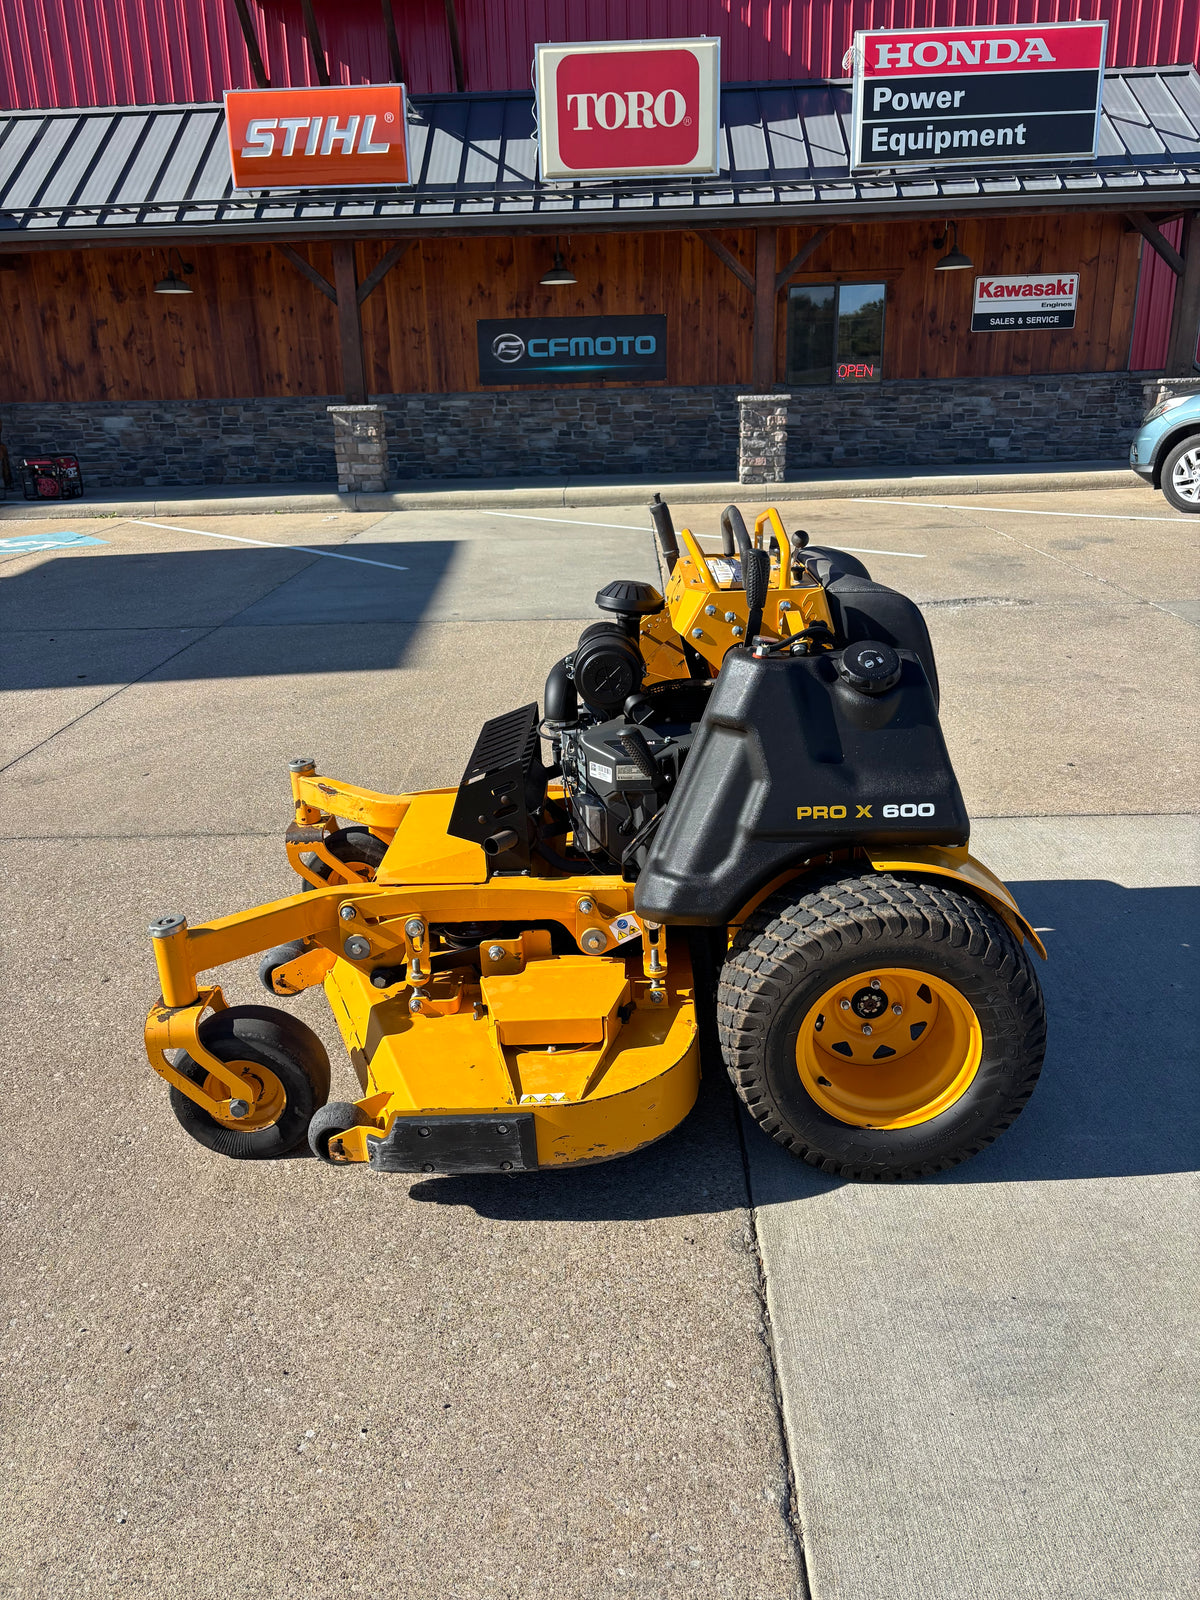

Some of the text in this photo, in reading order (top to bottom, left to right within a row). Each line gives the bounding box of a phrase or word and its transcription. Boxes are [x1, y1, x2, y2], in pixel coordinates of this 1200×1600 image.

[874, 37, 1057, 69] HONDA
[566, 89, 687, 131] TORO
[872, 86, 966, 112] Power
[240, 114, 391, 158] STIHL
[871, 122, 1027, 156] Equipment
[978, 278, 1075, 299] Kawasaki
[989, 315, 1060, 326] SALES & SERVICE
[527, 335, 657, 358] CFMOTO
[838, 364, 874, 378] OPEN
[796, 803, 936, 820] PRO X 600
